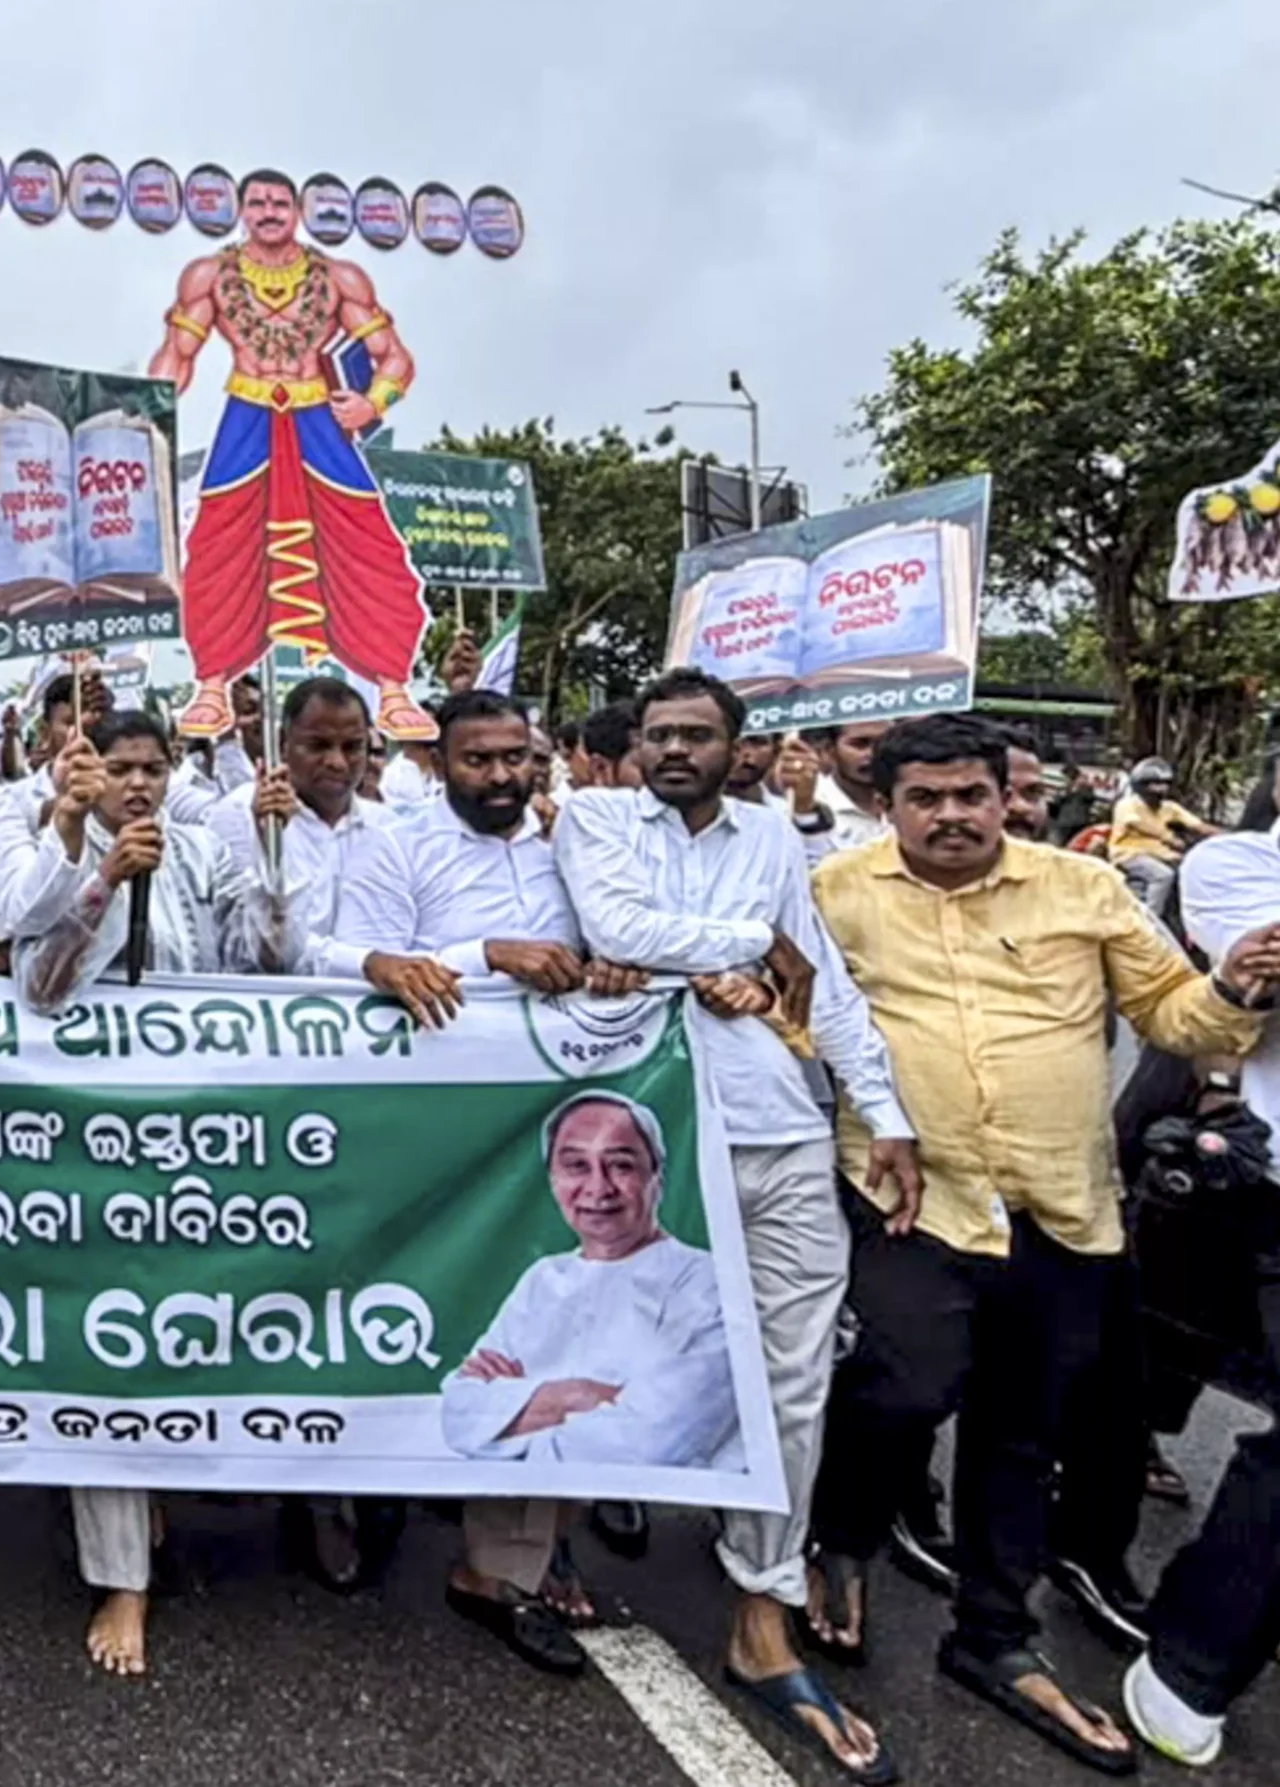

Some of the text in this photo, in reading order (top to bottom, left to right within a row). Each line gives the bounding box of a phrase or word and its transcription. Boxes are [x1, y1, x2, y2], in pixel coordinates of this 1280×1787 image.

[78, 456, 146, 500] ନିଉଟନ
[819, 558, 927, 608] ନିଉଟନ
[839, 690, 906, 713] ଜନତା
[52, 994, 420, 1057] ଆନ୍ଦୋଳନ
[84, 1113, 265, 1172] ଇସ୍ତଫା
[286, 1112, 338, 1165] ଓ
[103, 1174, 313, 1250] ଦାବିରେ
[83, 1282, 442, 1370] ଘେରାଉ
[51, 1406, 218, 1442] ଜନତା
[241, 1407, 345, 1443] ଦଳ
